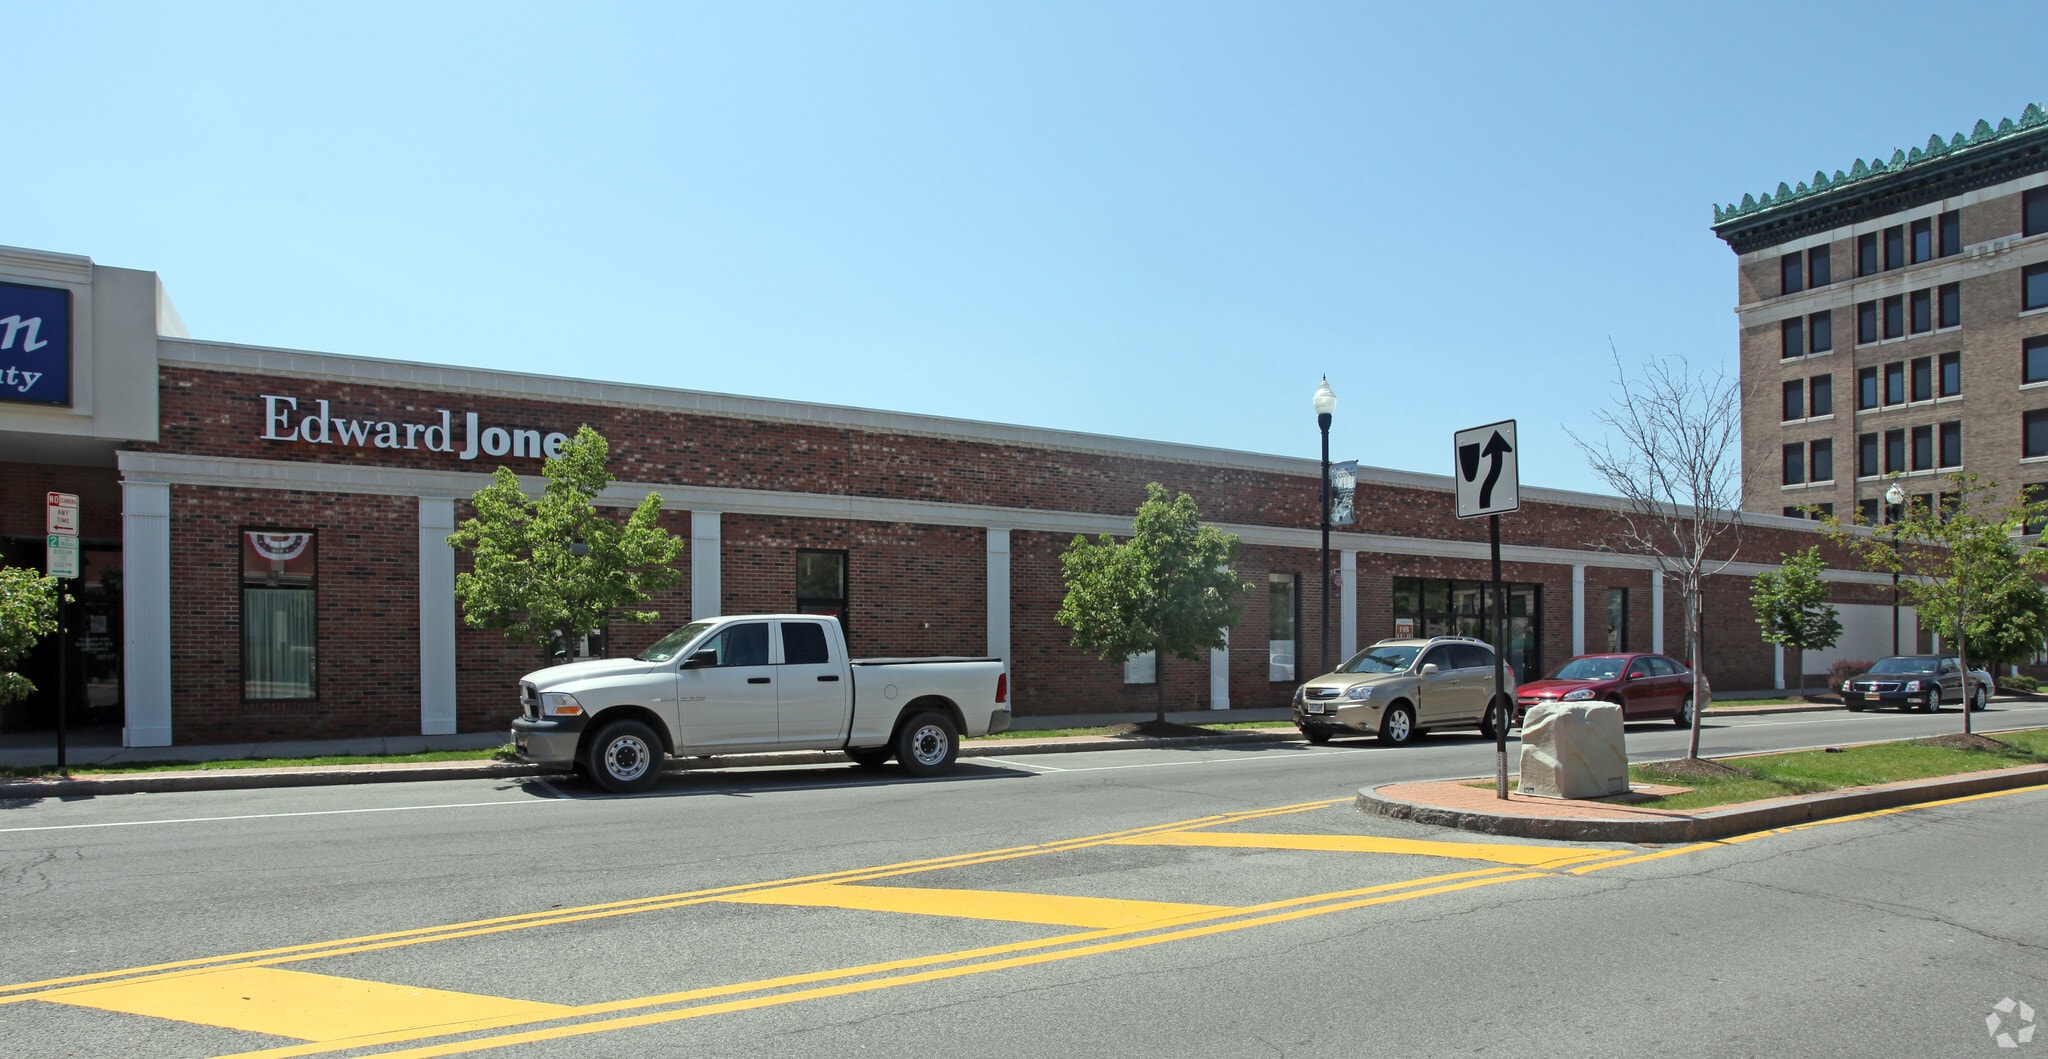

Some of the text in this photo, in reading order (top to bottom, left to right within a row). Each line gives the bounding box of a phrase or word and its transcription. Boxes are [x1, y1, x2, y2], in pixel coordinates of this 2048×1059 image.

[259, 394, 583, 461] Edward Jone
[49, 495, 59, 504] NO
[50, 536, 57, 547] 2
